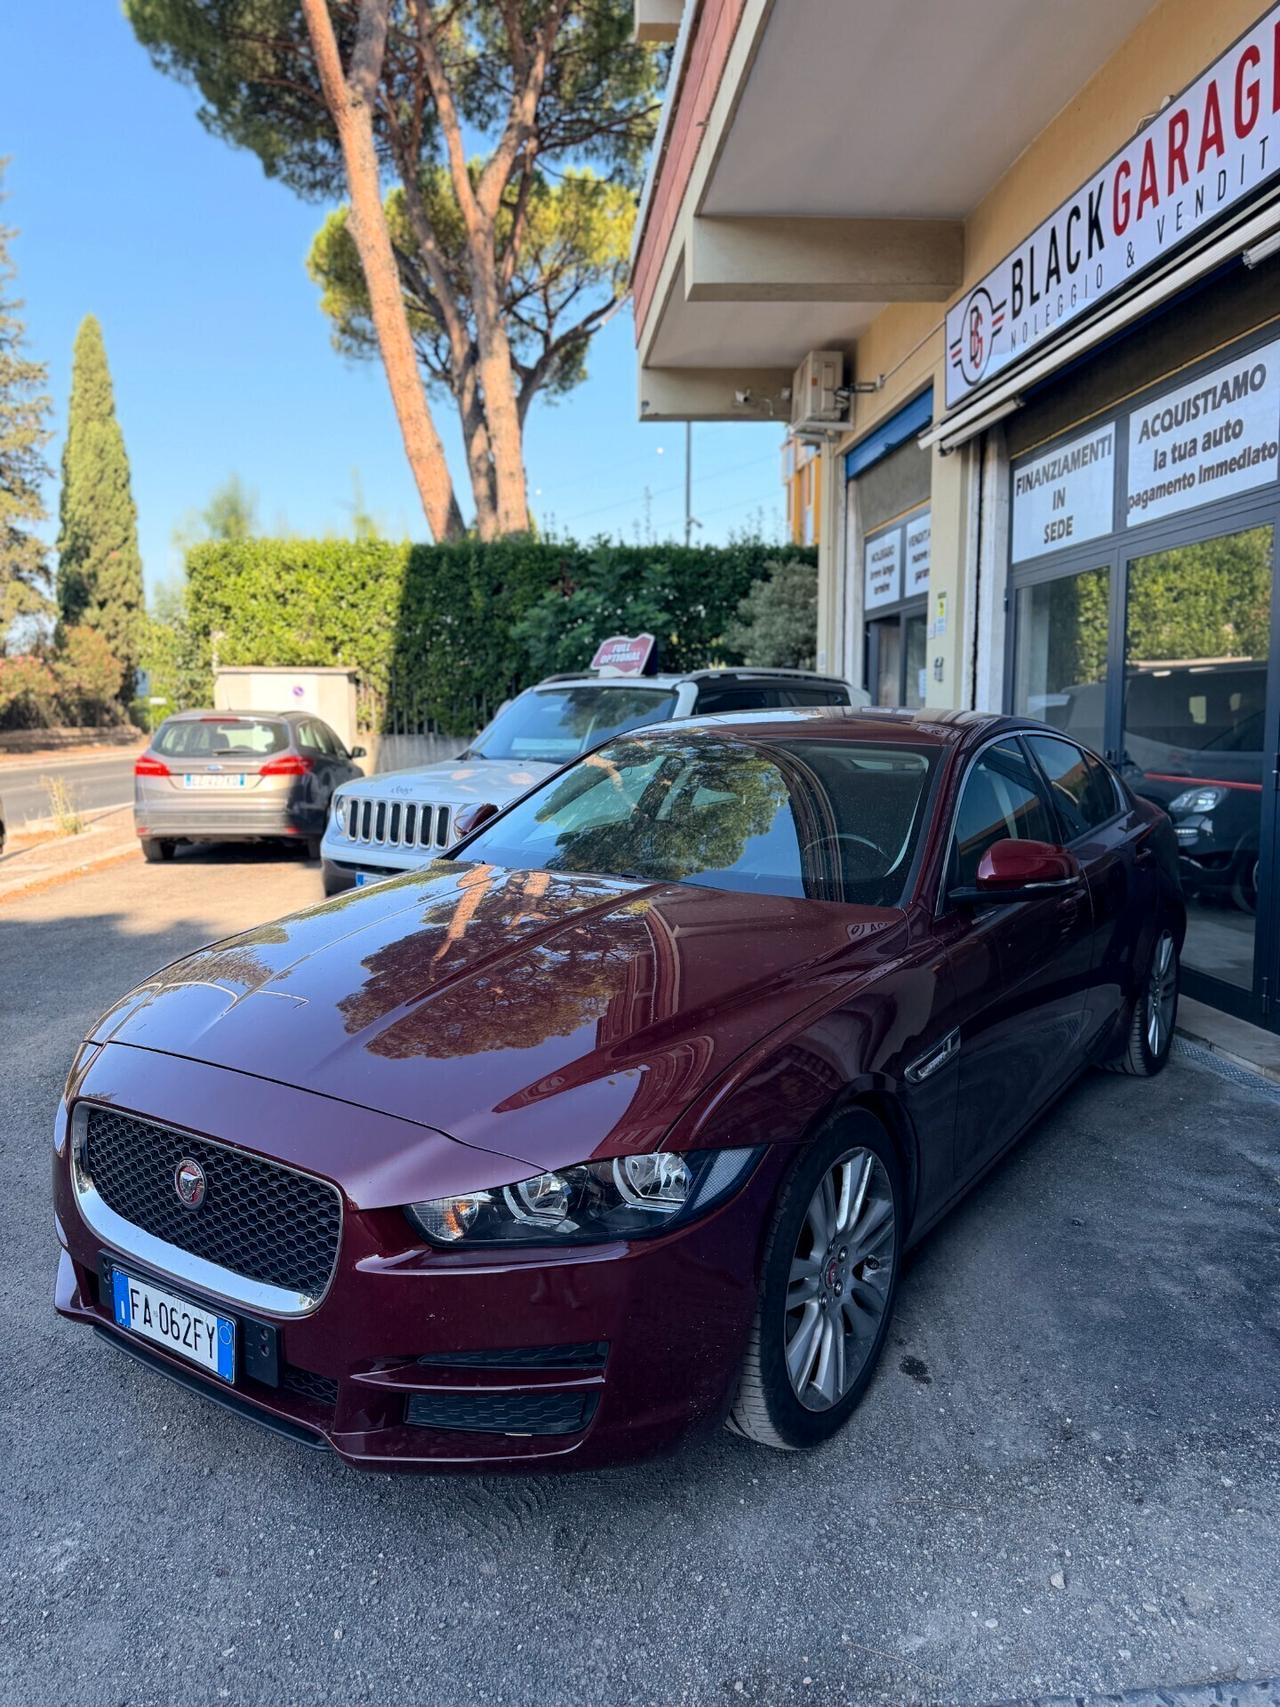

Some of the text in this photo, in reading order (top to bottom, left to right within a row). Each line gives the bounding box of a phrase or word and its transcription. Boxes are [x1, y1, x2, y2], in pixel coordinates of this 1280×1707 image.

[1011, 263, 1103, 352] NOLEGGIO
[1126, 241, 1135, 268] &
[1138, 363, 1267, 444] ACQUISTIAMO
[1016, 432, 1113, 497] FINANZIAMENTI
[1153, 418, 1244, 472] la tua auto
[1053, 487, 1066, 511] IN
[1127, 471, 1195, 514] pagamento
[1043, 515, 1074, 544] SEDE
